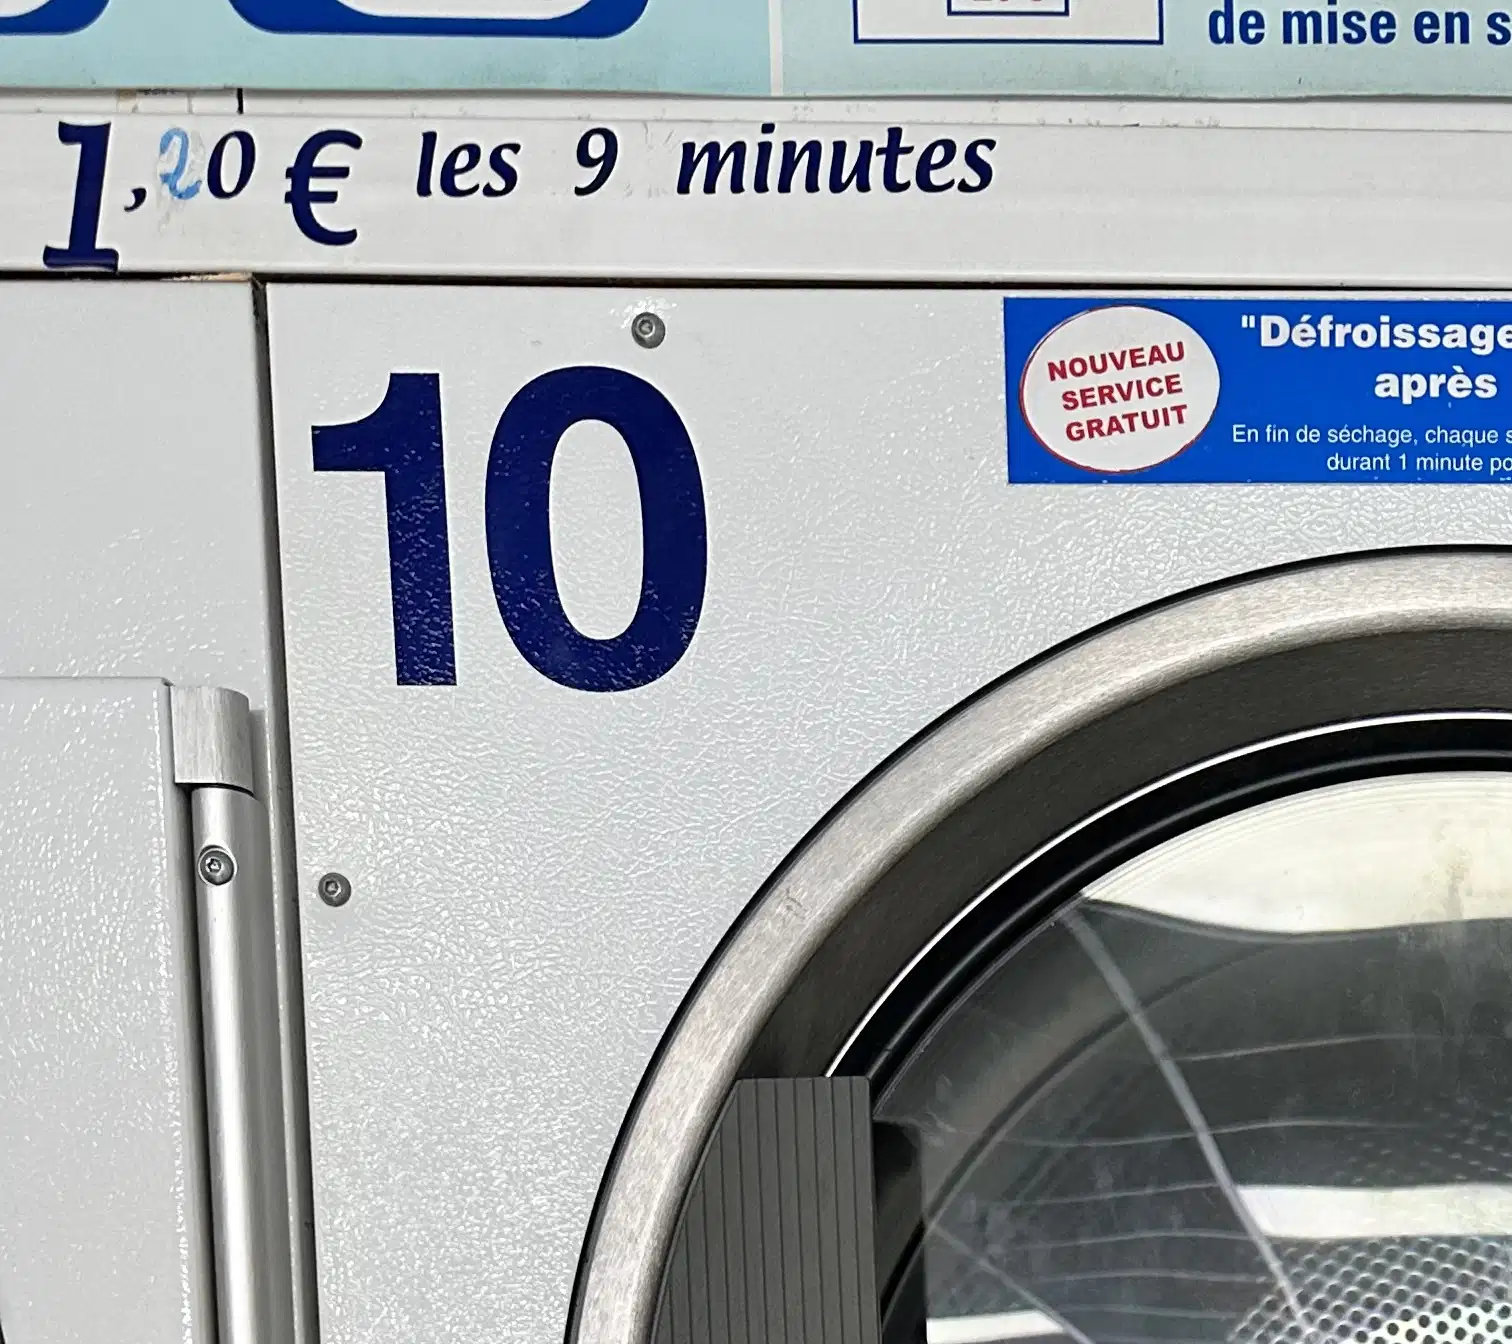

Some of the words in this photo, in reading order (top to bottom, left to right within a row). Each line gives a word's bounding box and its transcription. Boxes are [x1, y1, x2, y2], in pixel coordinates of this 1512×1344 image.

[1208, 0, 1265, 45] de
[1282, 0, 1396, 45] mise
[1414, 10, 1470, 44] en
[285, 129, 362, 246] €
[416, 130, 520, 198] les
[573, 128, 618, 196] 9
[676, 123, 996, 196] minutes
[1048, 341, 1185, 381] NOUVEAU
[1062, 364, 1183, 411] SERVICE
[1374, 365, 1498, 405] après
[1066, 404, 1187, 442] GRATUIT
[1232, 424, 1259, 443] En
[1265, 424, 1289, 443] fin
[1296, 424, 1321, 443] de
[1327, 425, 1418, 448] séchage,
[1425, 426, 1499, 449] chaque
[1327, 453, 1391, 471] durant
[1399, 454, 1407, 471] 1
[1416, 453, 1483, 472] minute
[311, 366, 708, 692] 10
